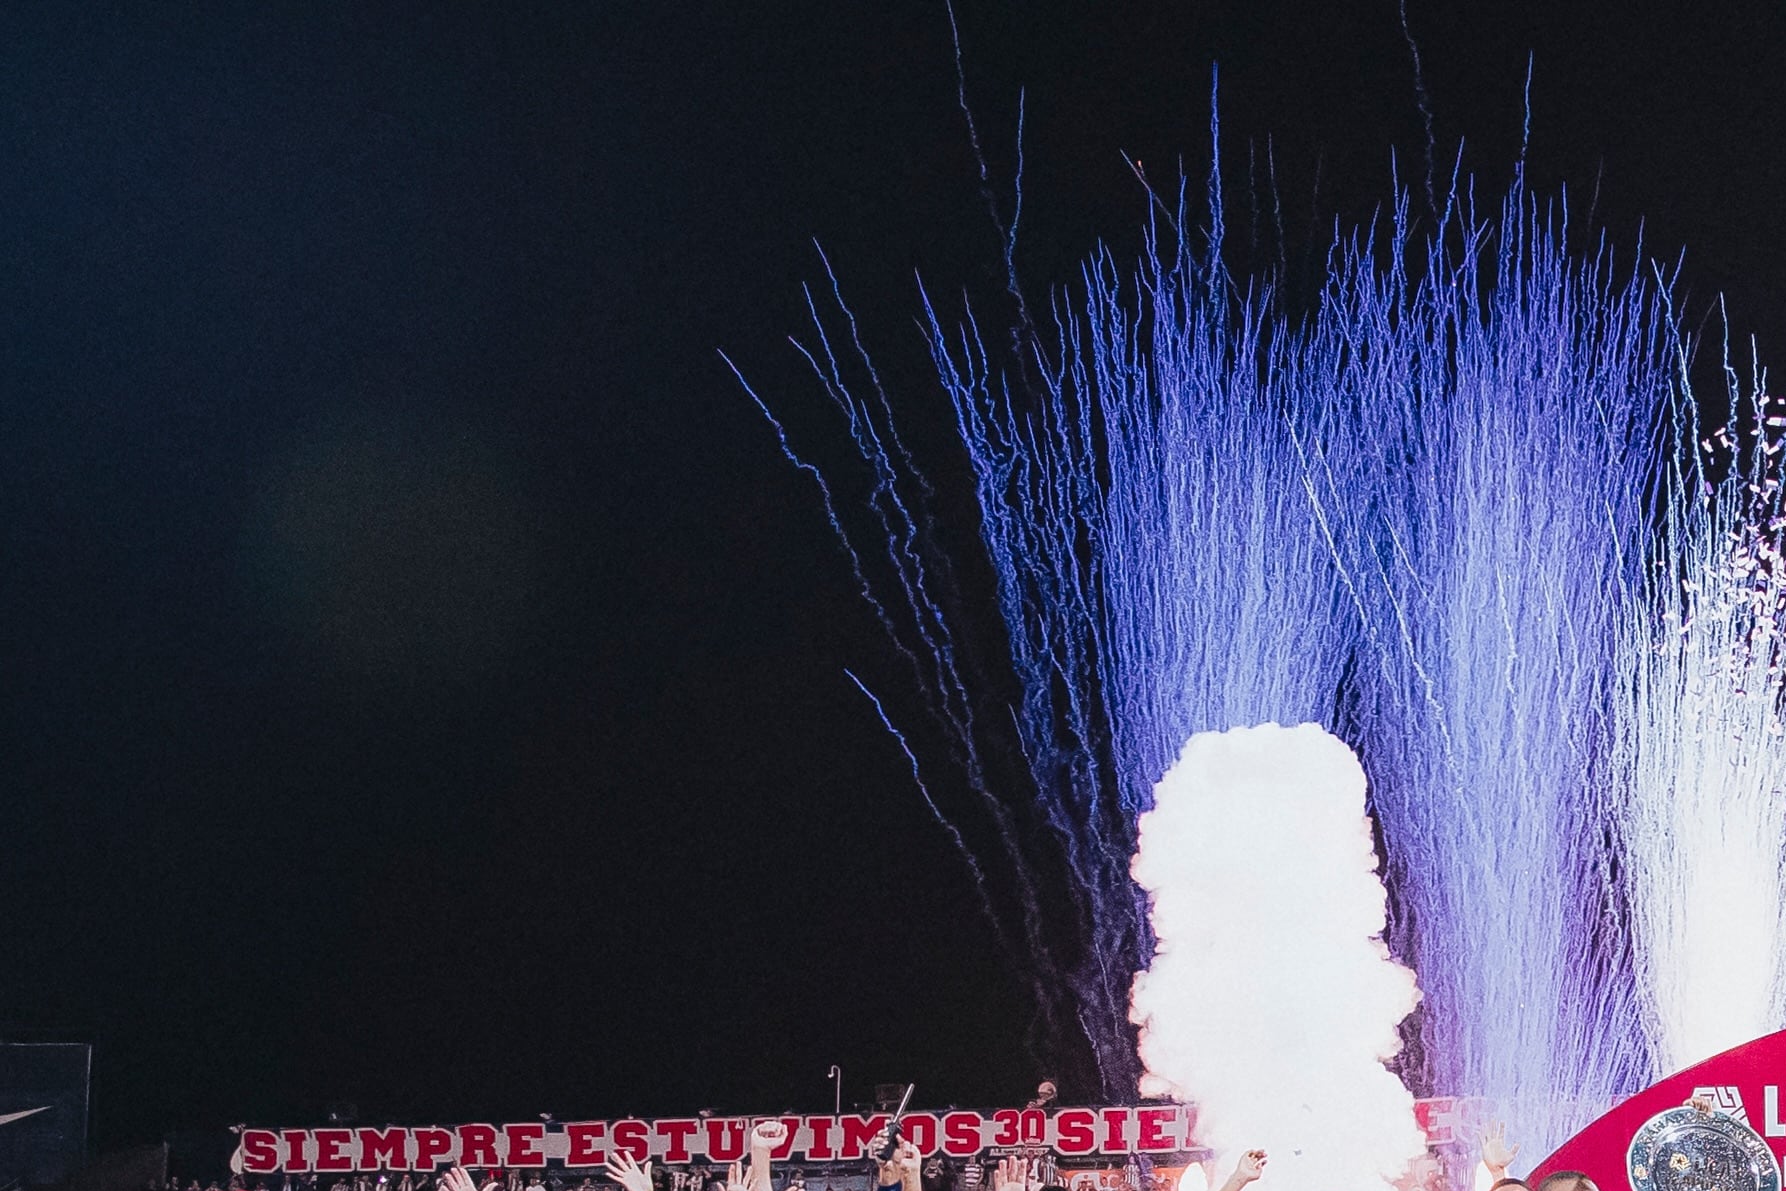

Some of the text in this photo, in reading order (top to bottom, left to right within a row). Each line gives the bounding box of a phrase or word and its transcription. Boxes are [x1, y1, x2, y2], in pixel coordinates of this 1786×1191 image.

[243, 1122, 546, 1173] SIEMPRE
[564, 1110, 984, 1169] ESTUVIMOS
[993, 1108, 1047, 1147] 30
